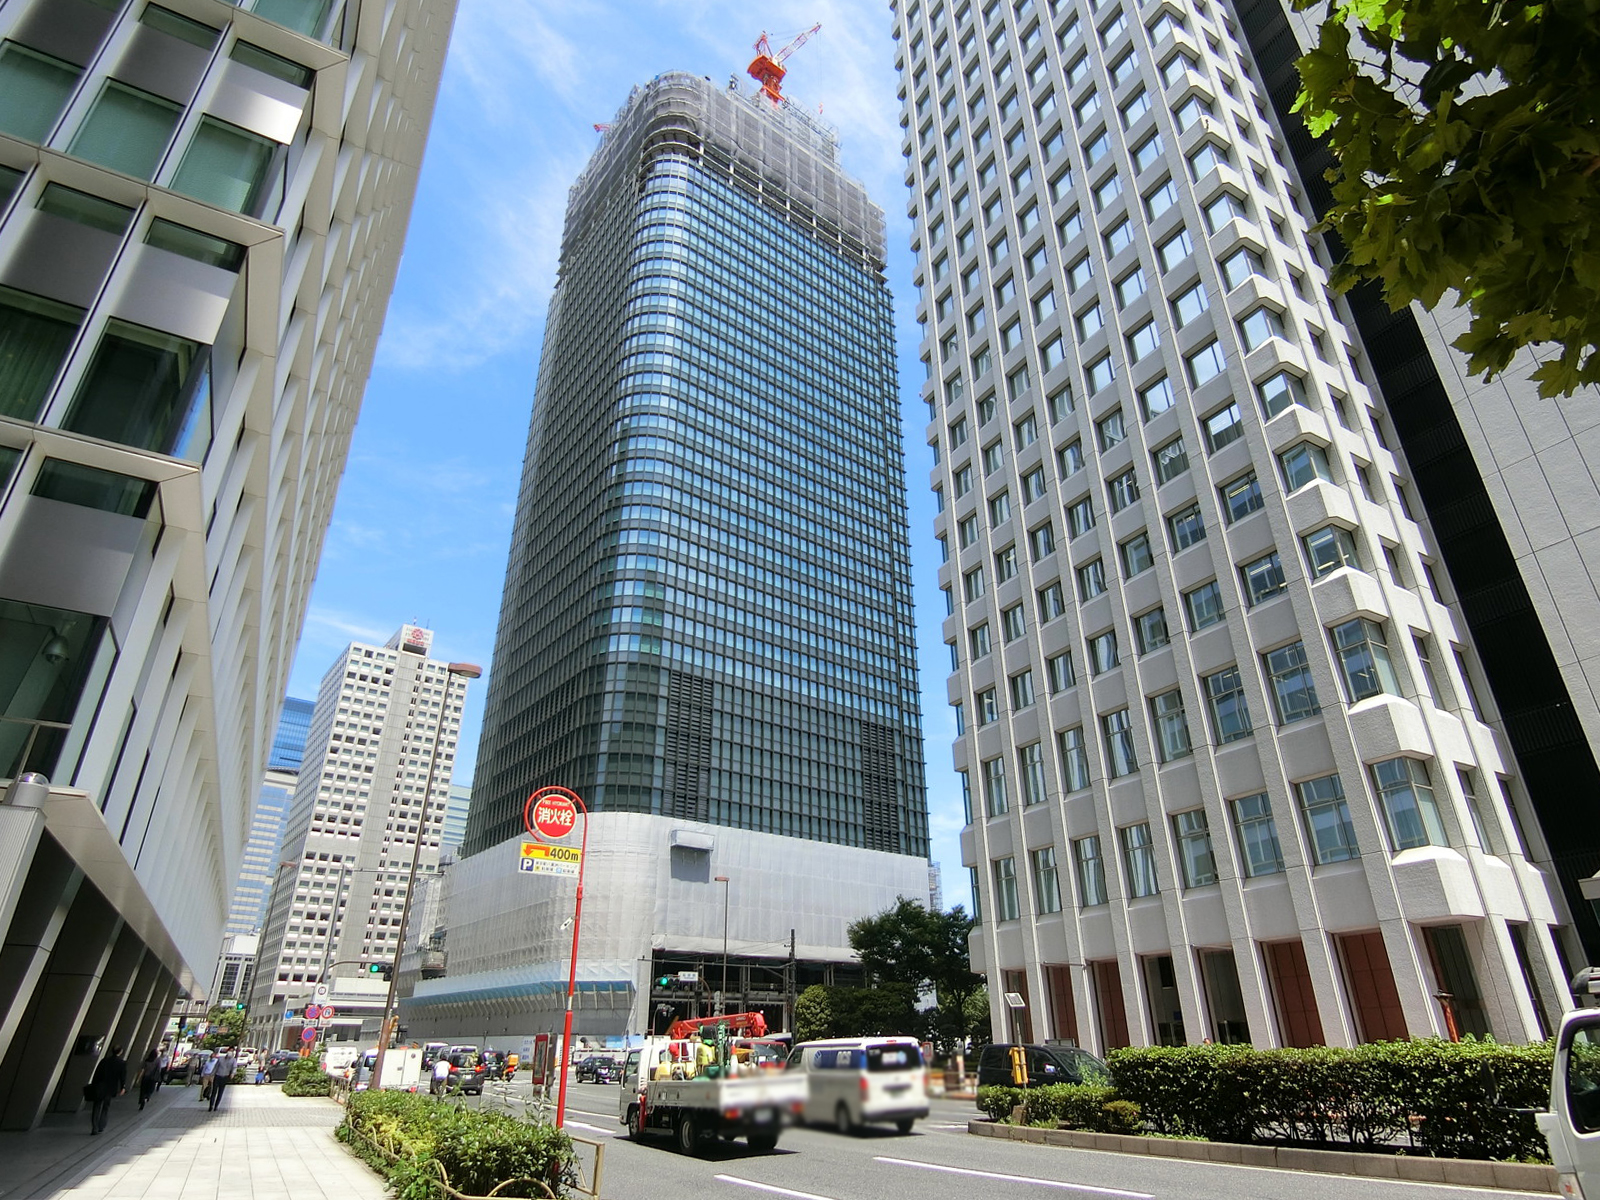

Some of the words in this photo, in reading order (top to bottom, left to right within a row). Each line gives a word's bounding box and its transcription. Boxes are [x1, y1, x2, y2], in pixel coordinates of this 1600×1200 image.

[538, 806, 573, 826] 消火栓
[550, 848, 579, 861] 400m
[523, 858, 532, 870] P
